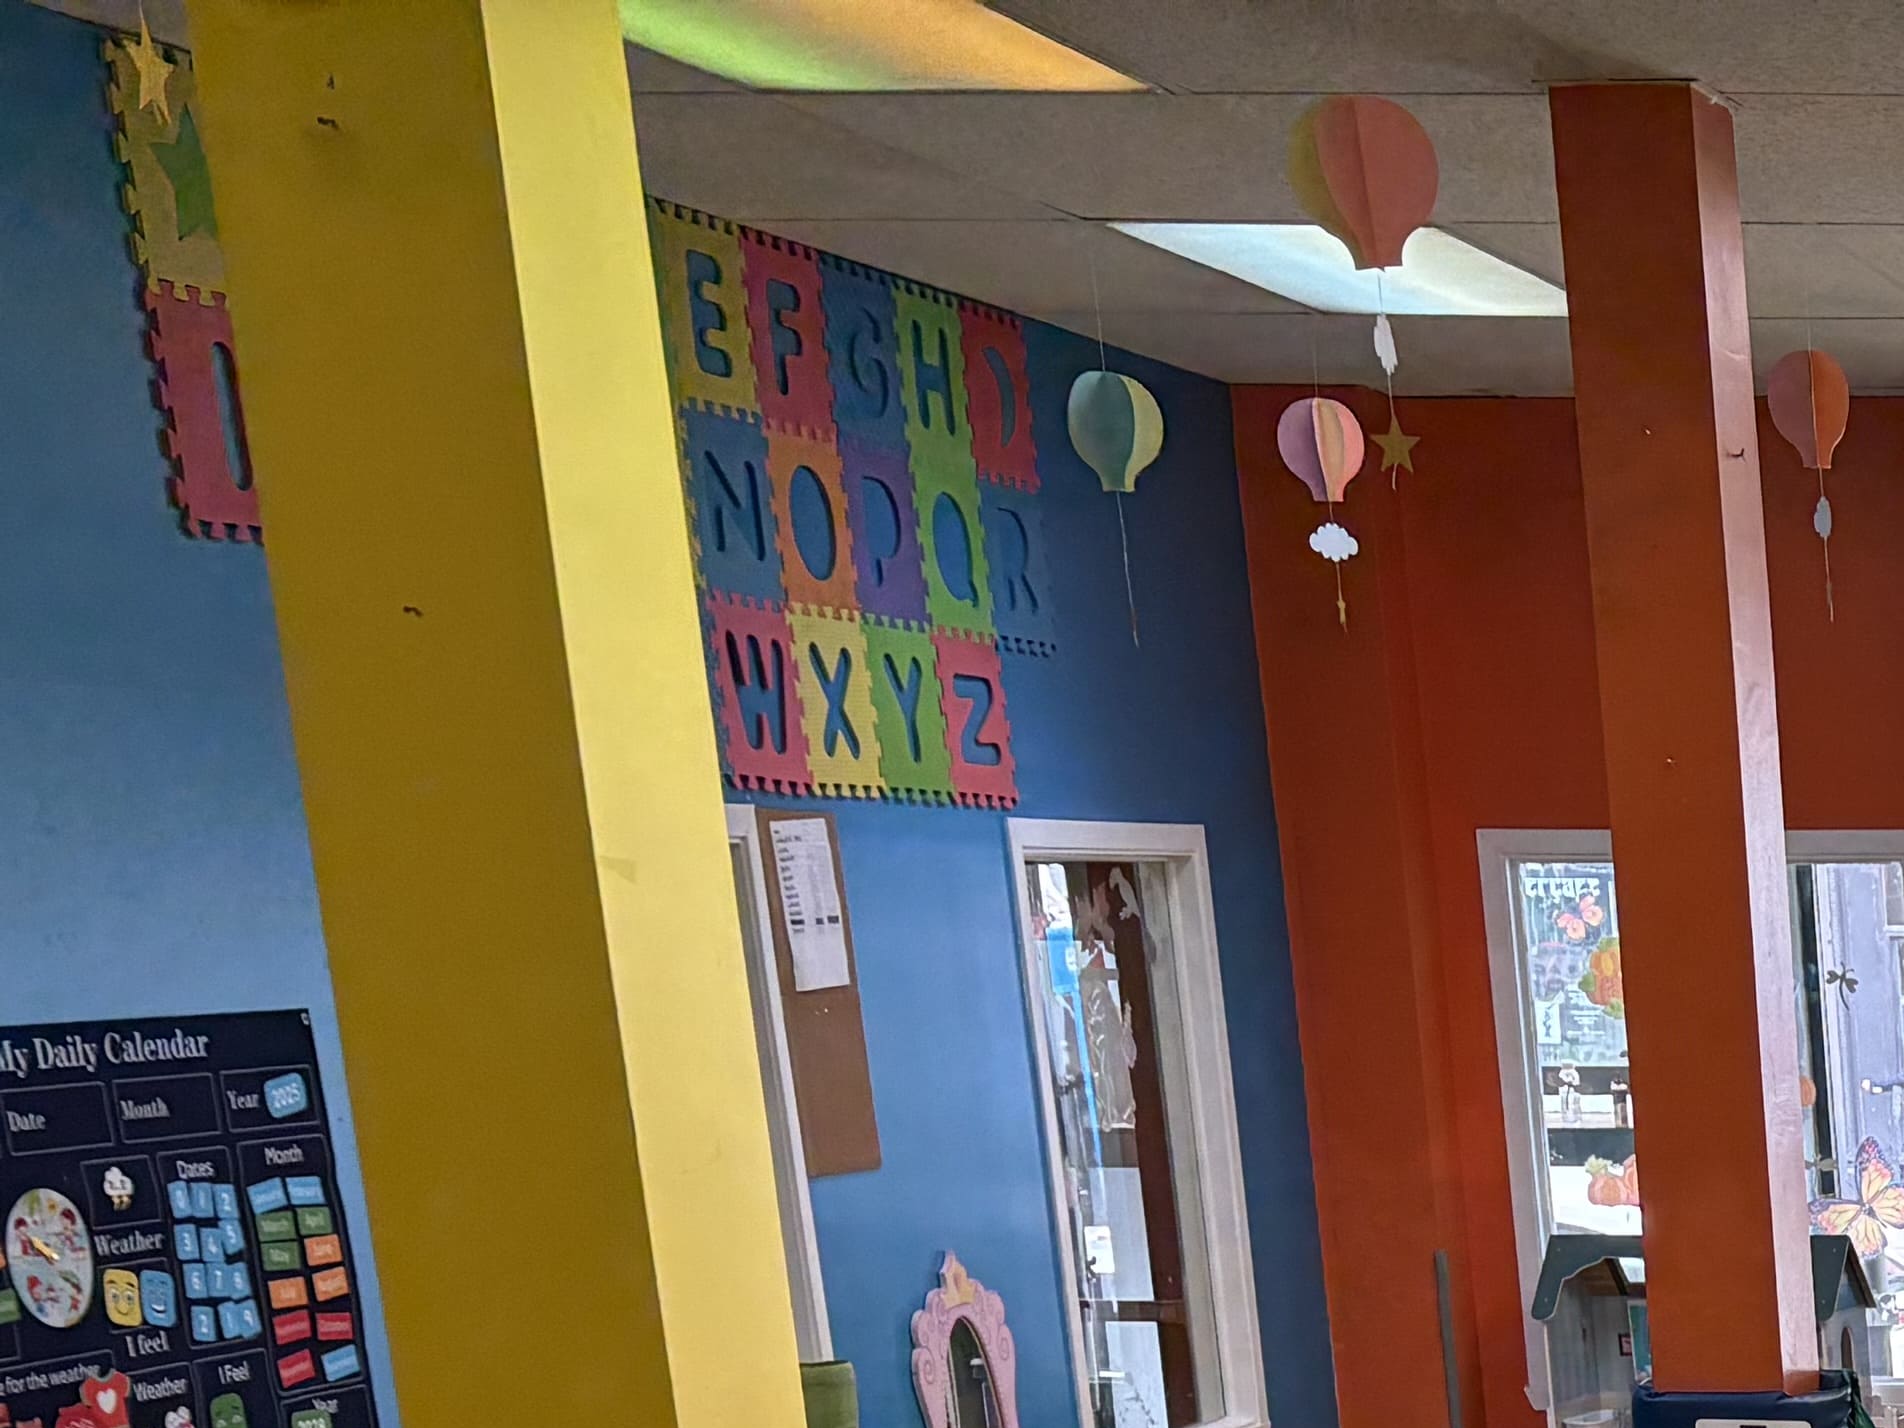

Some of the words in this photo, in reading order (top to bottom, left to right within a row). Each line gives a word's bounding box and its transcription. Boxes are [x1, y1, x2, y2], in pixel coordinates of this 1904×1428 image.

[686, 249, 732, 378] E
[766, 279, 802, 396] F
[912, 319, 955, 437] H
[808, 641, 860, 760] X
[883, 652, 922, 764] Y
[953, 672, 1001, 766] Z
[32, 1035, 99, 1072] Daily
[104, 1029, 209, 1064] Calendar
[119, 1098, 170, 1120] Month
[226, 1090, 259, 1110] Year
[7, 1111, 46, 1132] Date
[176, 1160, 215, 1179] Dates
[94, 1230, 164, 1256] Weather
[138, 1330, 170, 1355] feel
[226, 1361, 250, 1382] Feel
[134, 1376, 188, 1401] Weather
